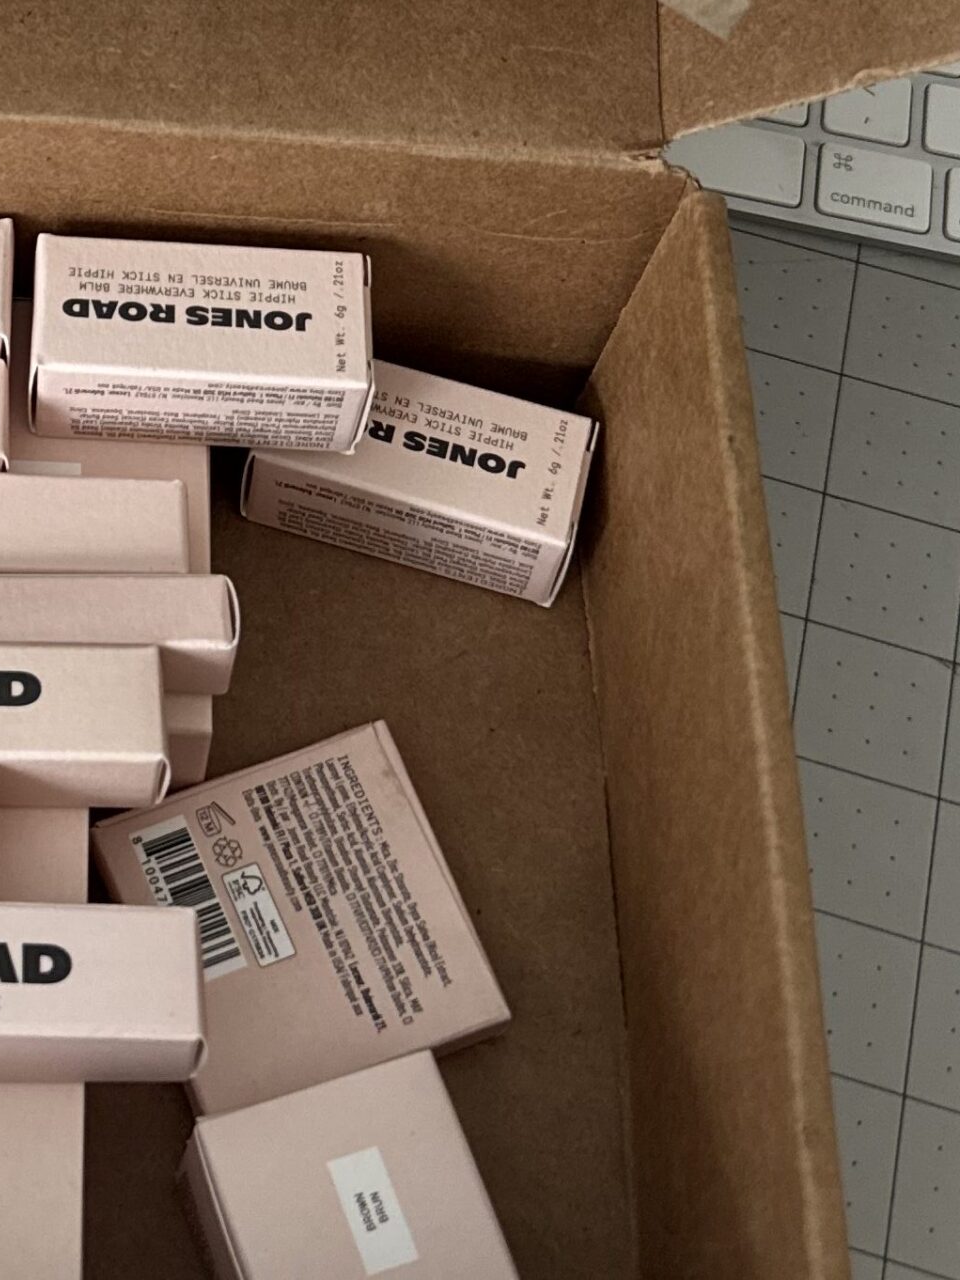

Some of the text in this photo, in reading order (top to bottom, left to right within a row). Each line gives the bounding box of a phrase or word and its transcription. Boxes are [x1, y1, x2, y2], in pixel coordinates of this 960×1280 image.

[830, 191, 915, 218] command
[69, 267, 307, 291] BAUME UNIVERSEL EN STICK HIPPIE
[80, 282, 295, 304] HIPPIE STICK EVERYWHERE BALM
[62, 298, 313, 332] JONES ROAD
[335, 305, 347, 319] 6g
[336, 353, 346, 373] Net
[395, 396, 410, 407] EN
[417, 402, 483, 428] UNIVERSEL
[364, 420, 395, 444] R
[425, 419, 462, 436] STICK
[490, 422, 528, 441] BAUME
[469, 430, 514, 451] HIPPIE
[403, 431, 526, 479] JONES
[536, 507, 550, 526] Net
[548, 462, 561, 475] 6g
[353, 1192, 377, 1232] BROWN
[369, 1191, 389, 1223] BRUN
